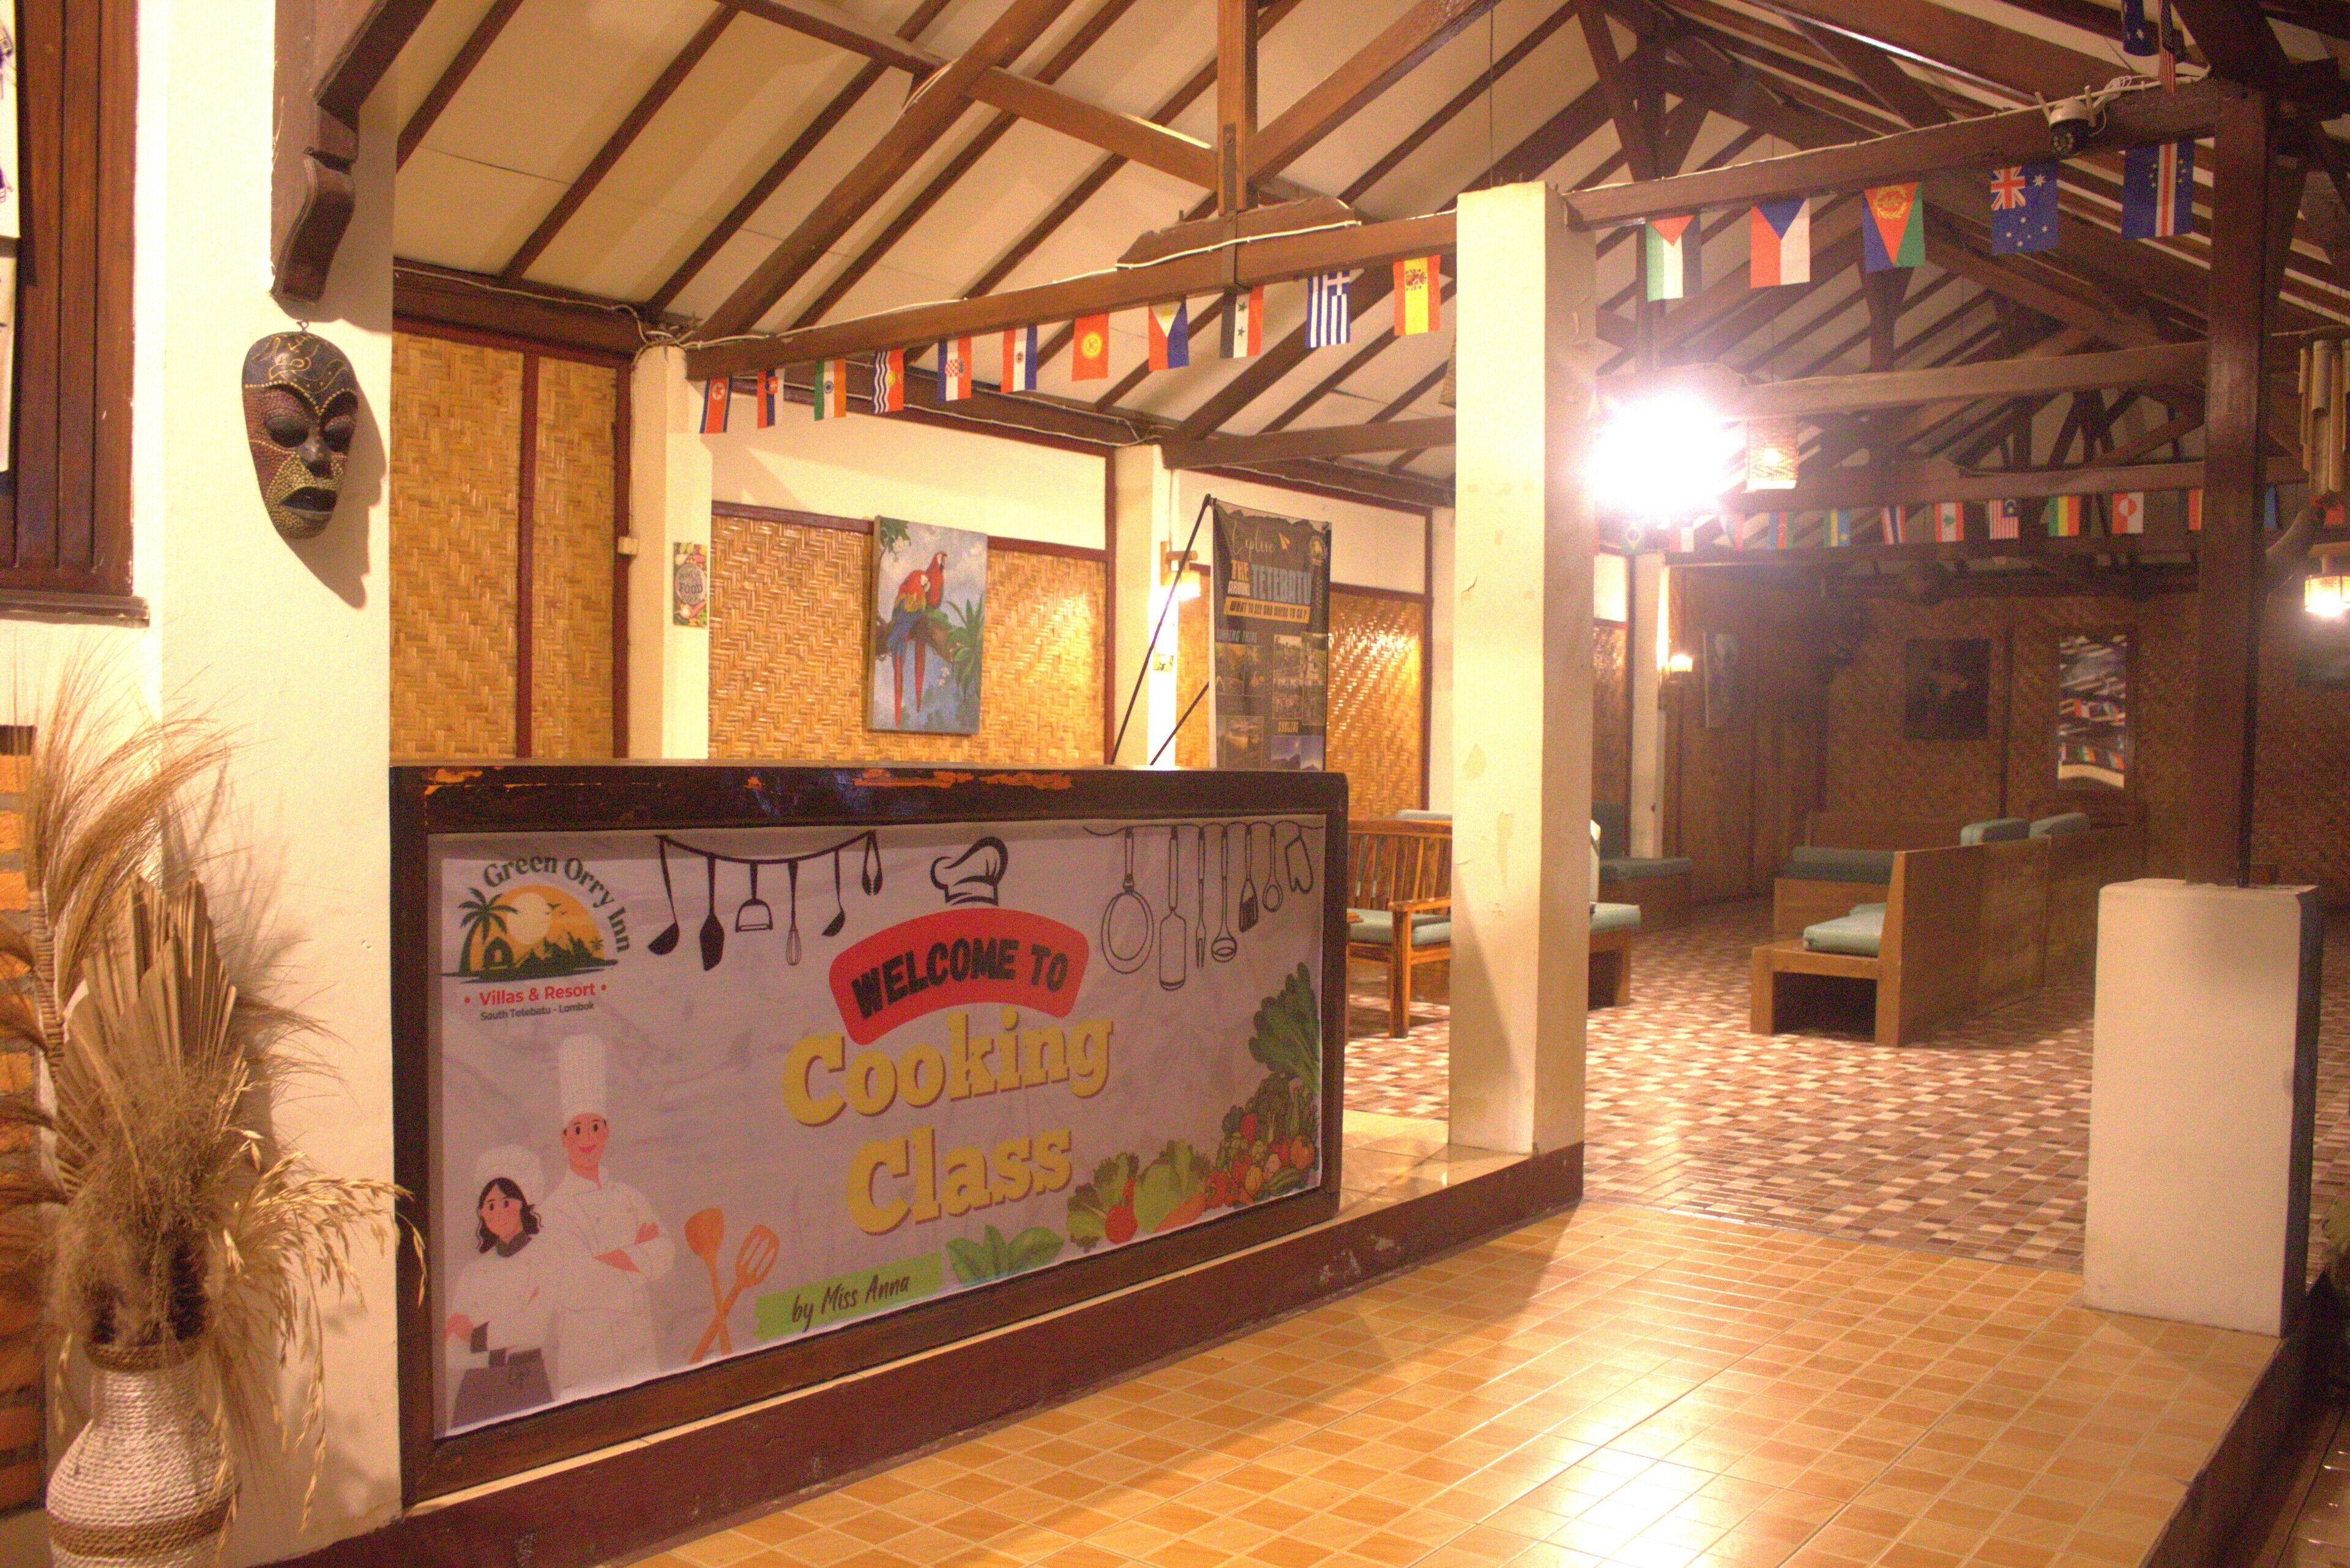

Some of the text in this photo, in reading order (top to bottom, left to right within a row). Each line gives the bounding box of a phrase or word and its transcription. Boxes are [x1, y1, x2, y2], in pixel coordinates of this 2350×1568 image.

[679, 582, 703, 594] FOOD
[1231, 559, 1249, 582] THE
[1251, 564, 1311, 605] TETEBATU
[483, 856, 630, 953] Green Orry Inn
[479, 983, 595, 1006] Villas & Resort
[851, 937, 1069, 1020] WELCOME TO
[480, 1010, 508, 1021] South
[511, 1006, 551, 1018] Tetebatu
[558, 1001, 594, 1014] Lombok
[782, 1005, 1114, 1127] Cooking
[846, 1125, 1072, 1236] Class
[791, 1274, 911, 1333] by Miss Anna
